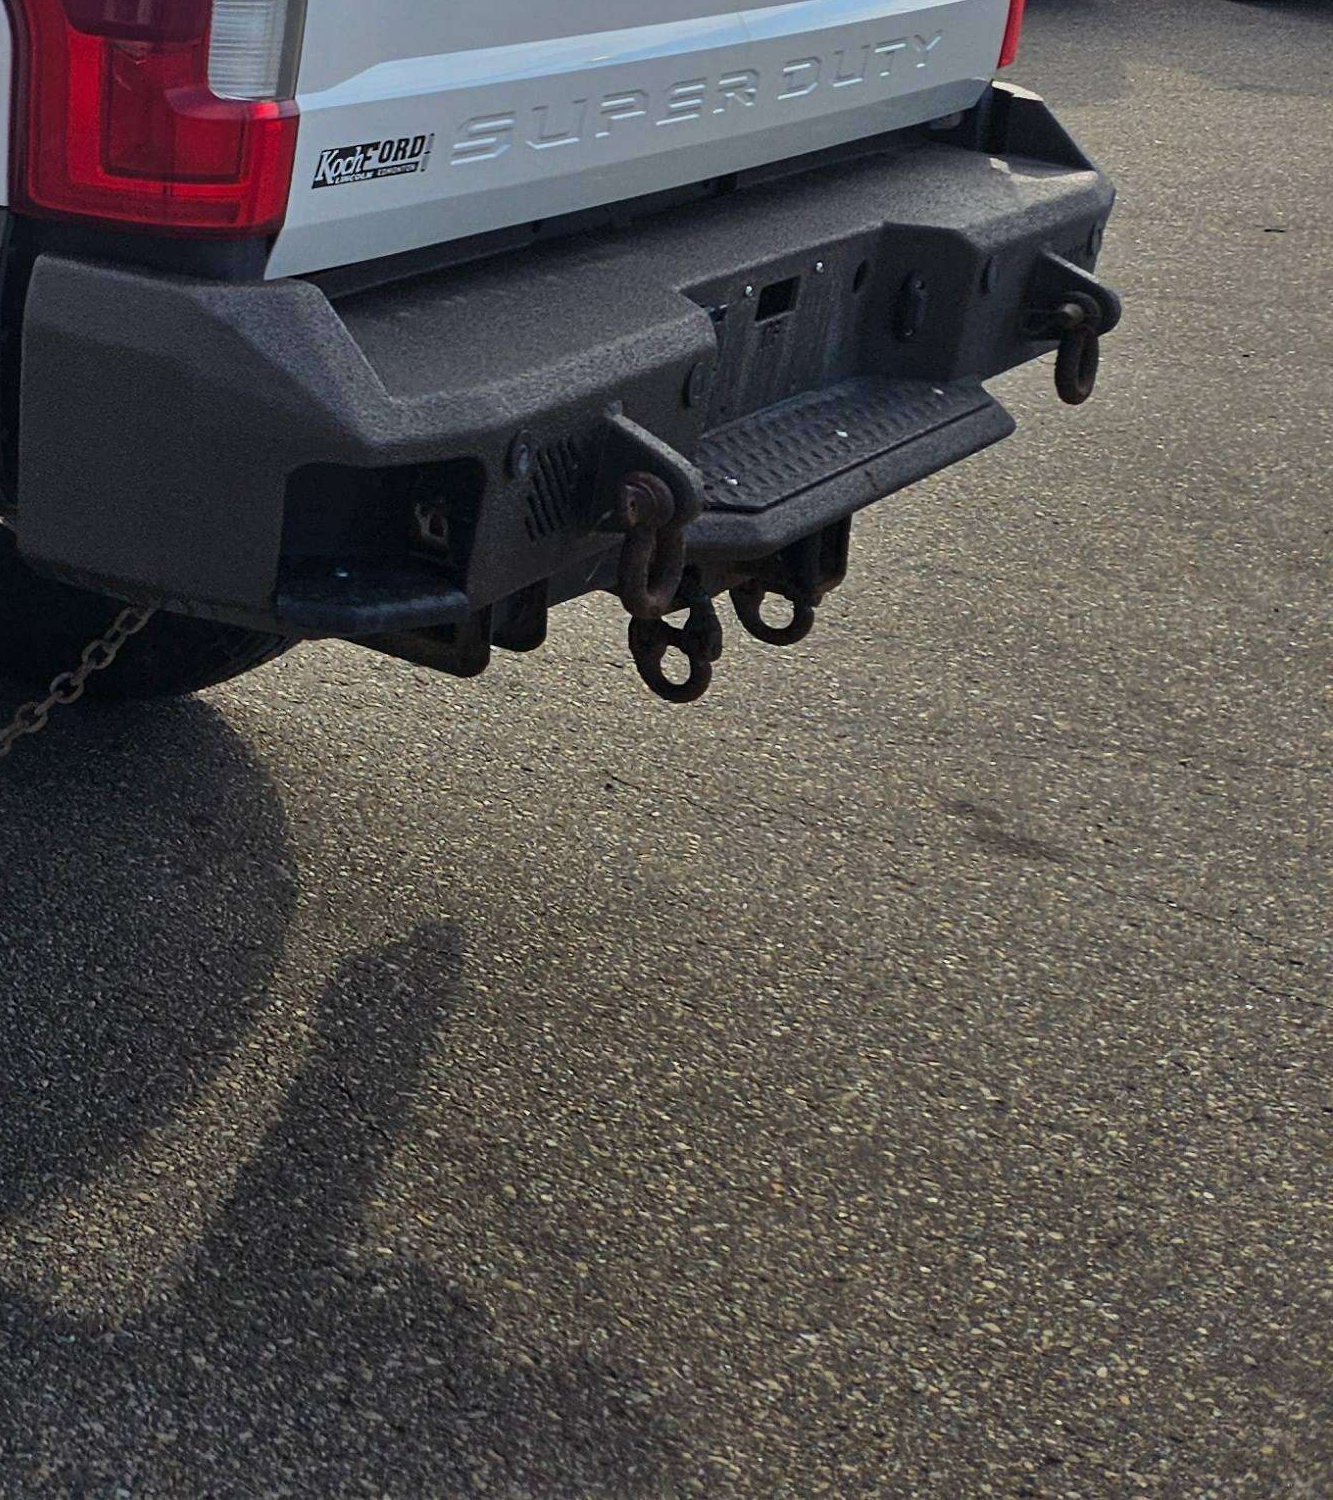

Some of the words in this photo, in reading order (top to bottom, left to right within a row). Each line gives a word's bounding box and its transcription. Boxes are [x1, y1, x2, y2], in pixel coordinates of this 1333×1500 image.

[450, 69, 761, 166] SUPER
[776, 29, 944, 100] DUTY
[314, 146, 365, 185] Koch
[363, 135, 426, 170] FORD
